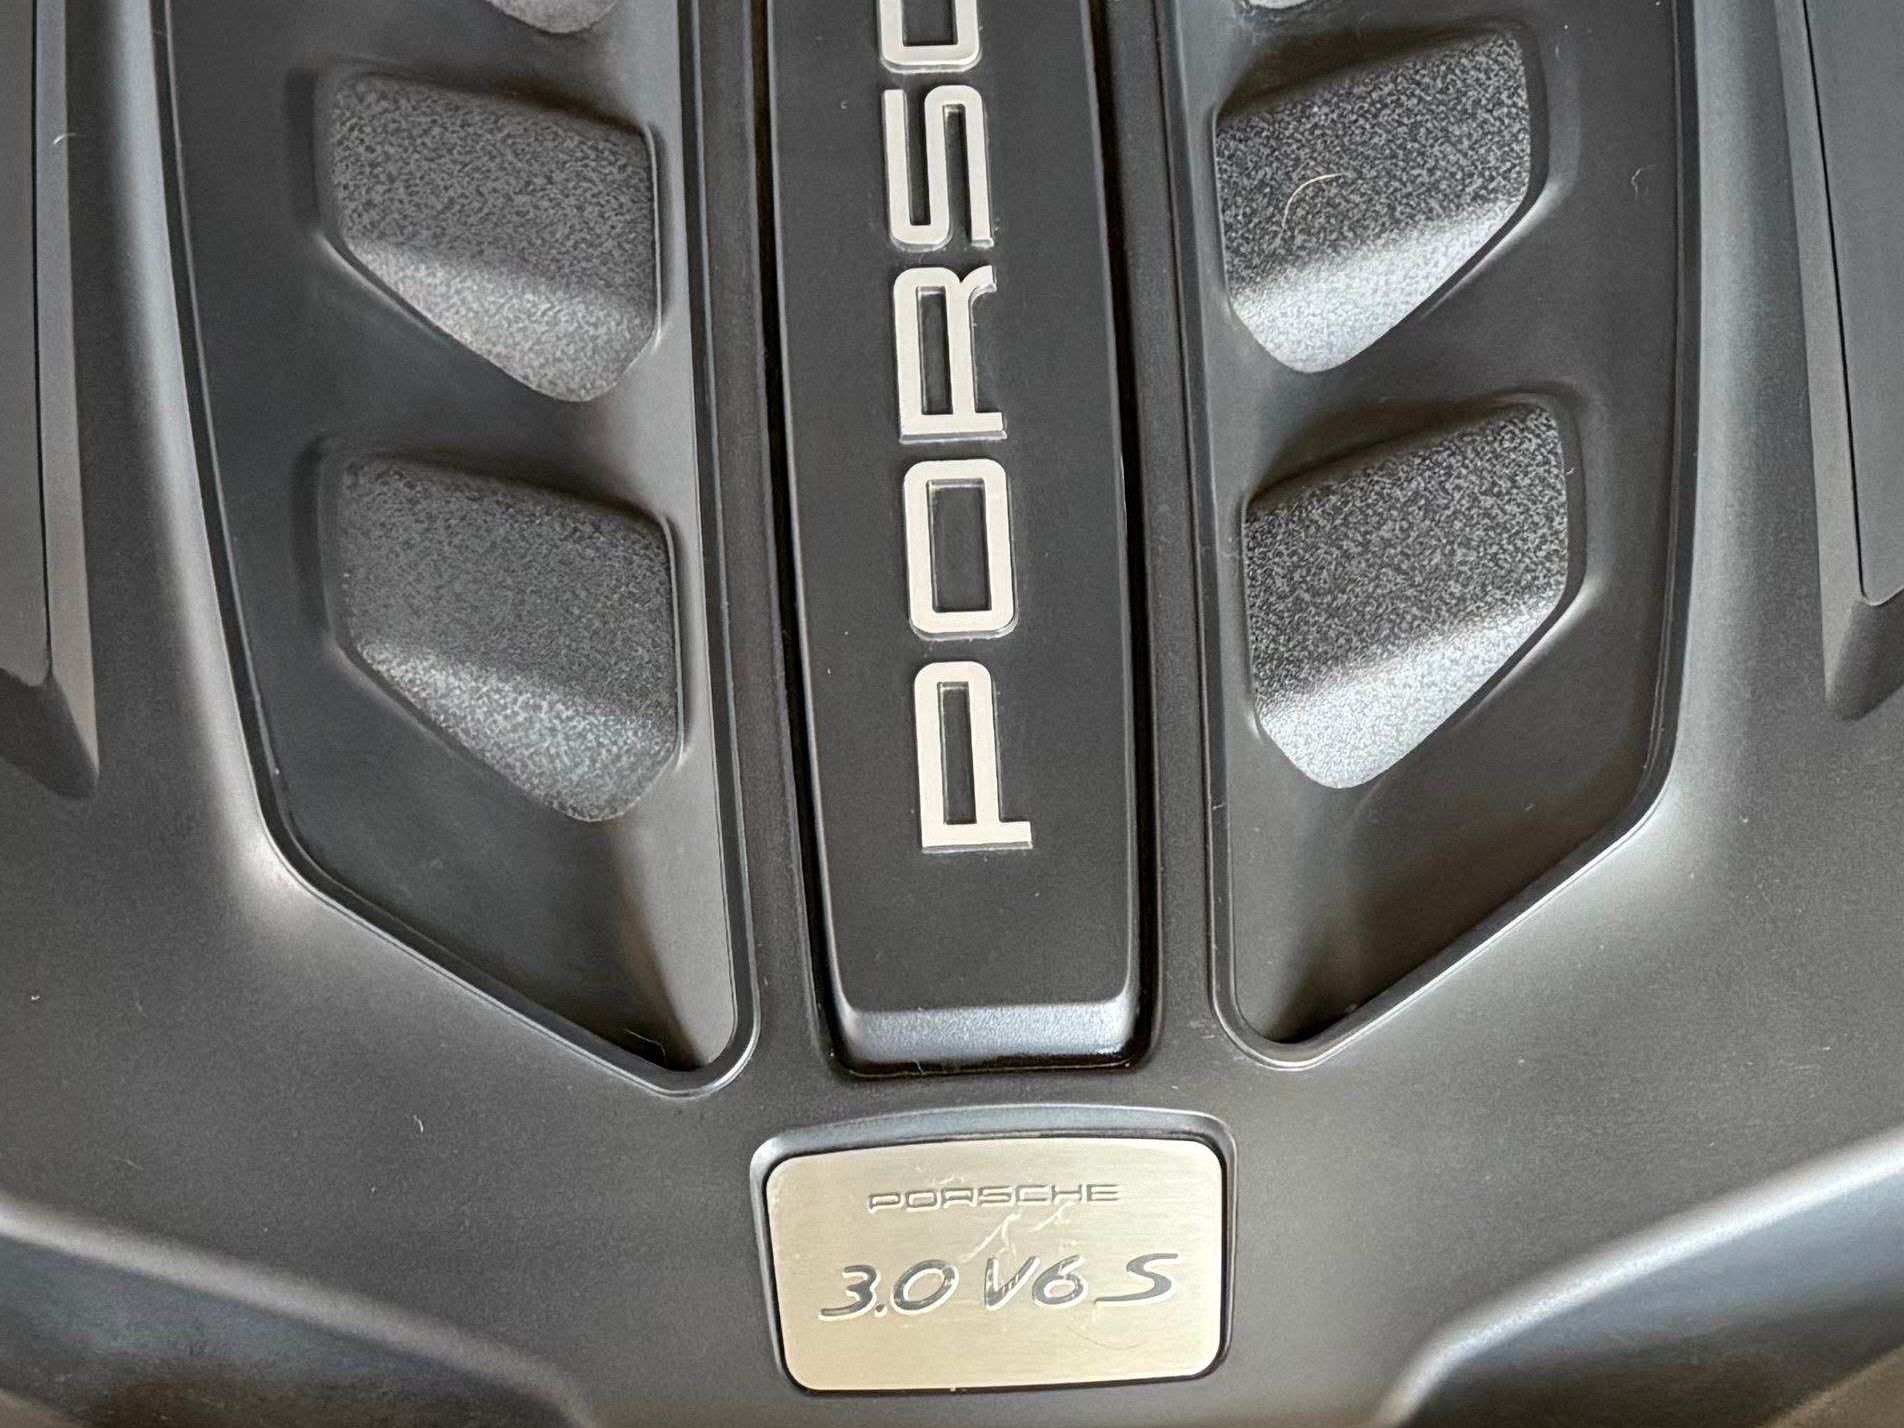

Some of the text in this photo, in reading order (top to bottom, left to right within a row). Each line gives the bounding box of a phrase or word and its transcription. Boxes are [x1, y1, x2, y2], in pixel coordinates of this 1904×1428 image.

[867, 1184, 1121, 1213] PORSCHE
[818, 1252, 1181, 1320] 3.0 V6 S
